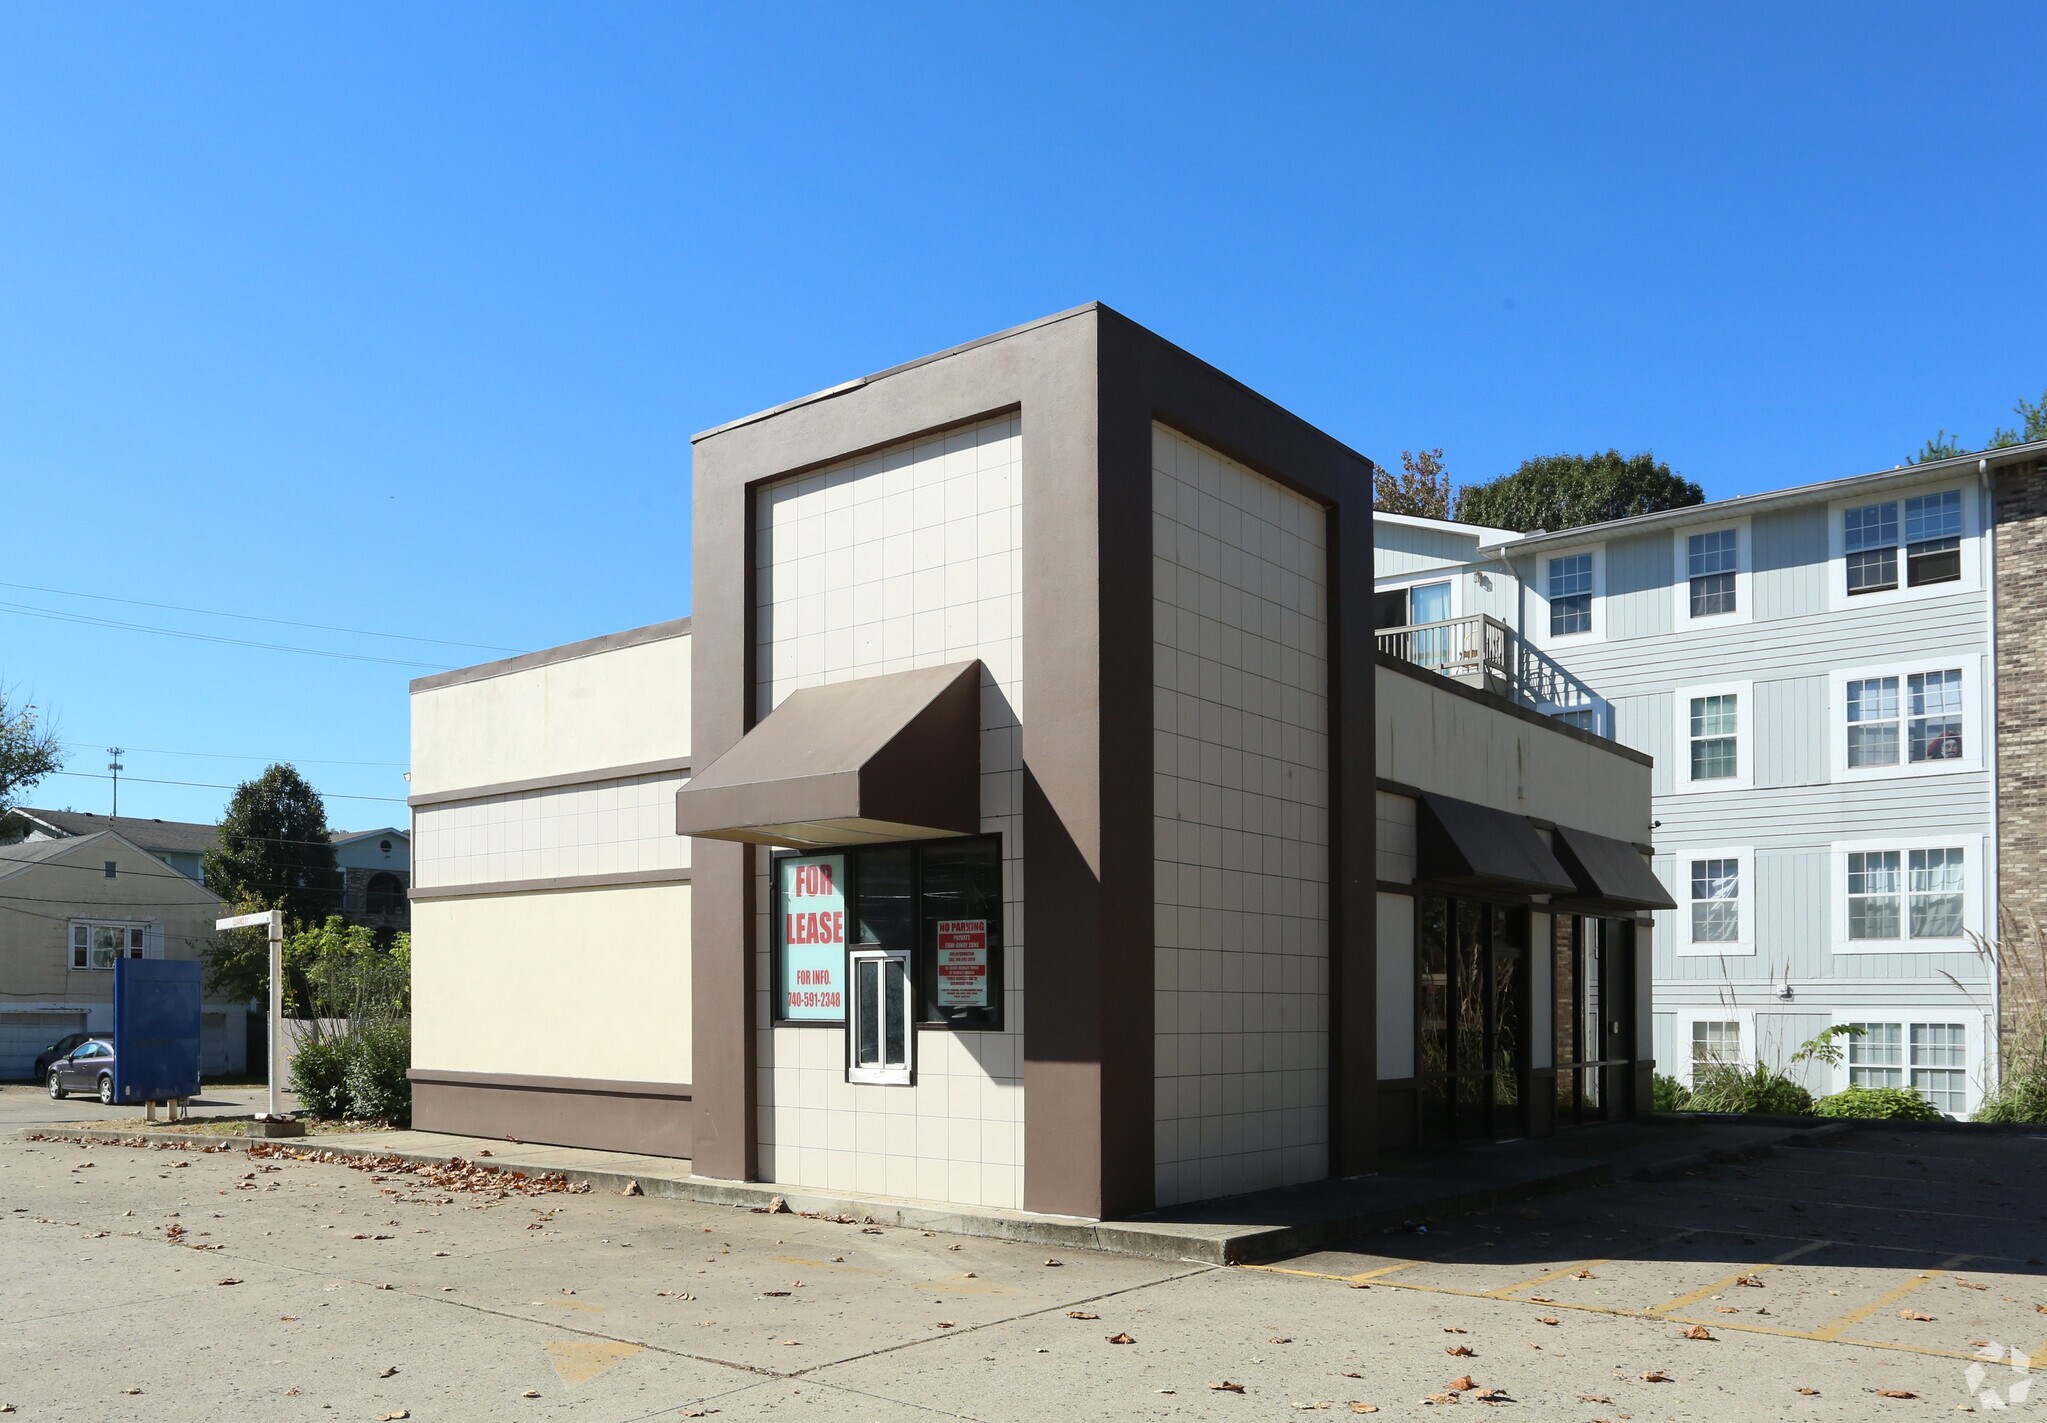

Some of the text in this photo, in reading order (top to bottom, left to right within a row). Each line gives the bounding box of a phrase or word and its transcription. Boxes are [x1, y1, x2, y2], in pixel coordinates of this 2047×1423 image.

[795, 864, 832, 897] FOR
[787, 911, 843, 944] LEASE
[940, 922, 985, 932] NO PARKING
[796, 969, 831, 985] FOR INFO.
[788, 992, 840, 1007] 740-591-2348
